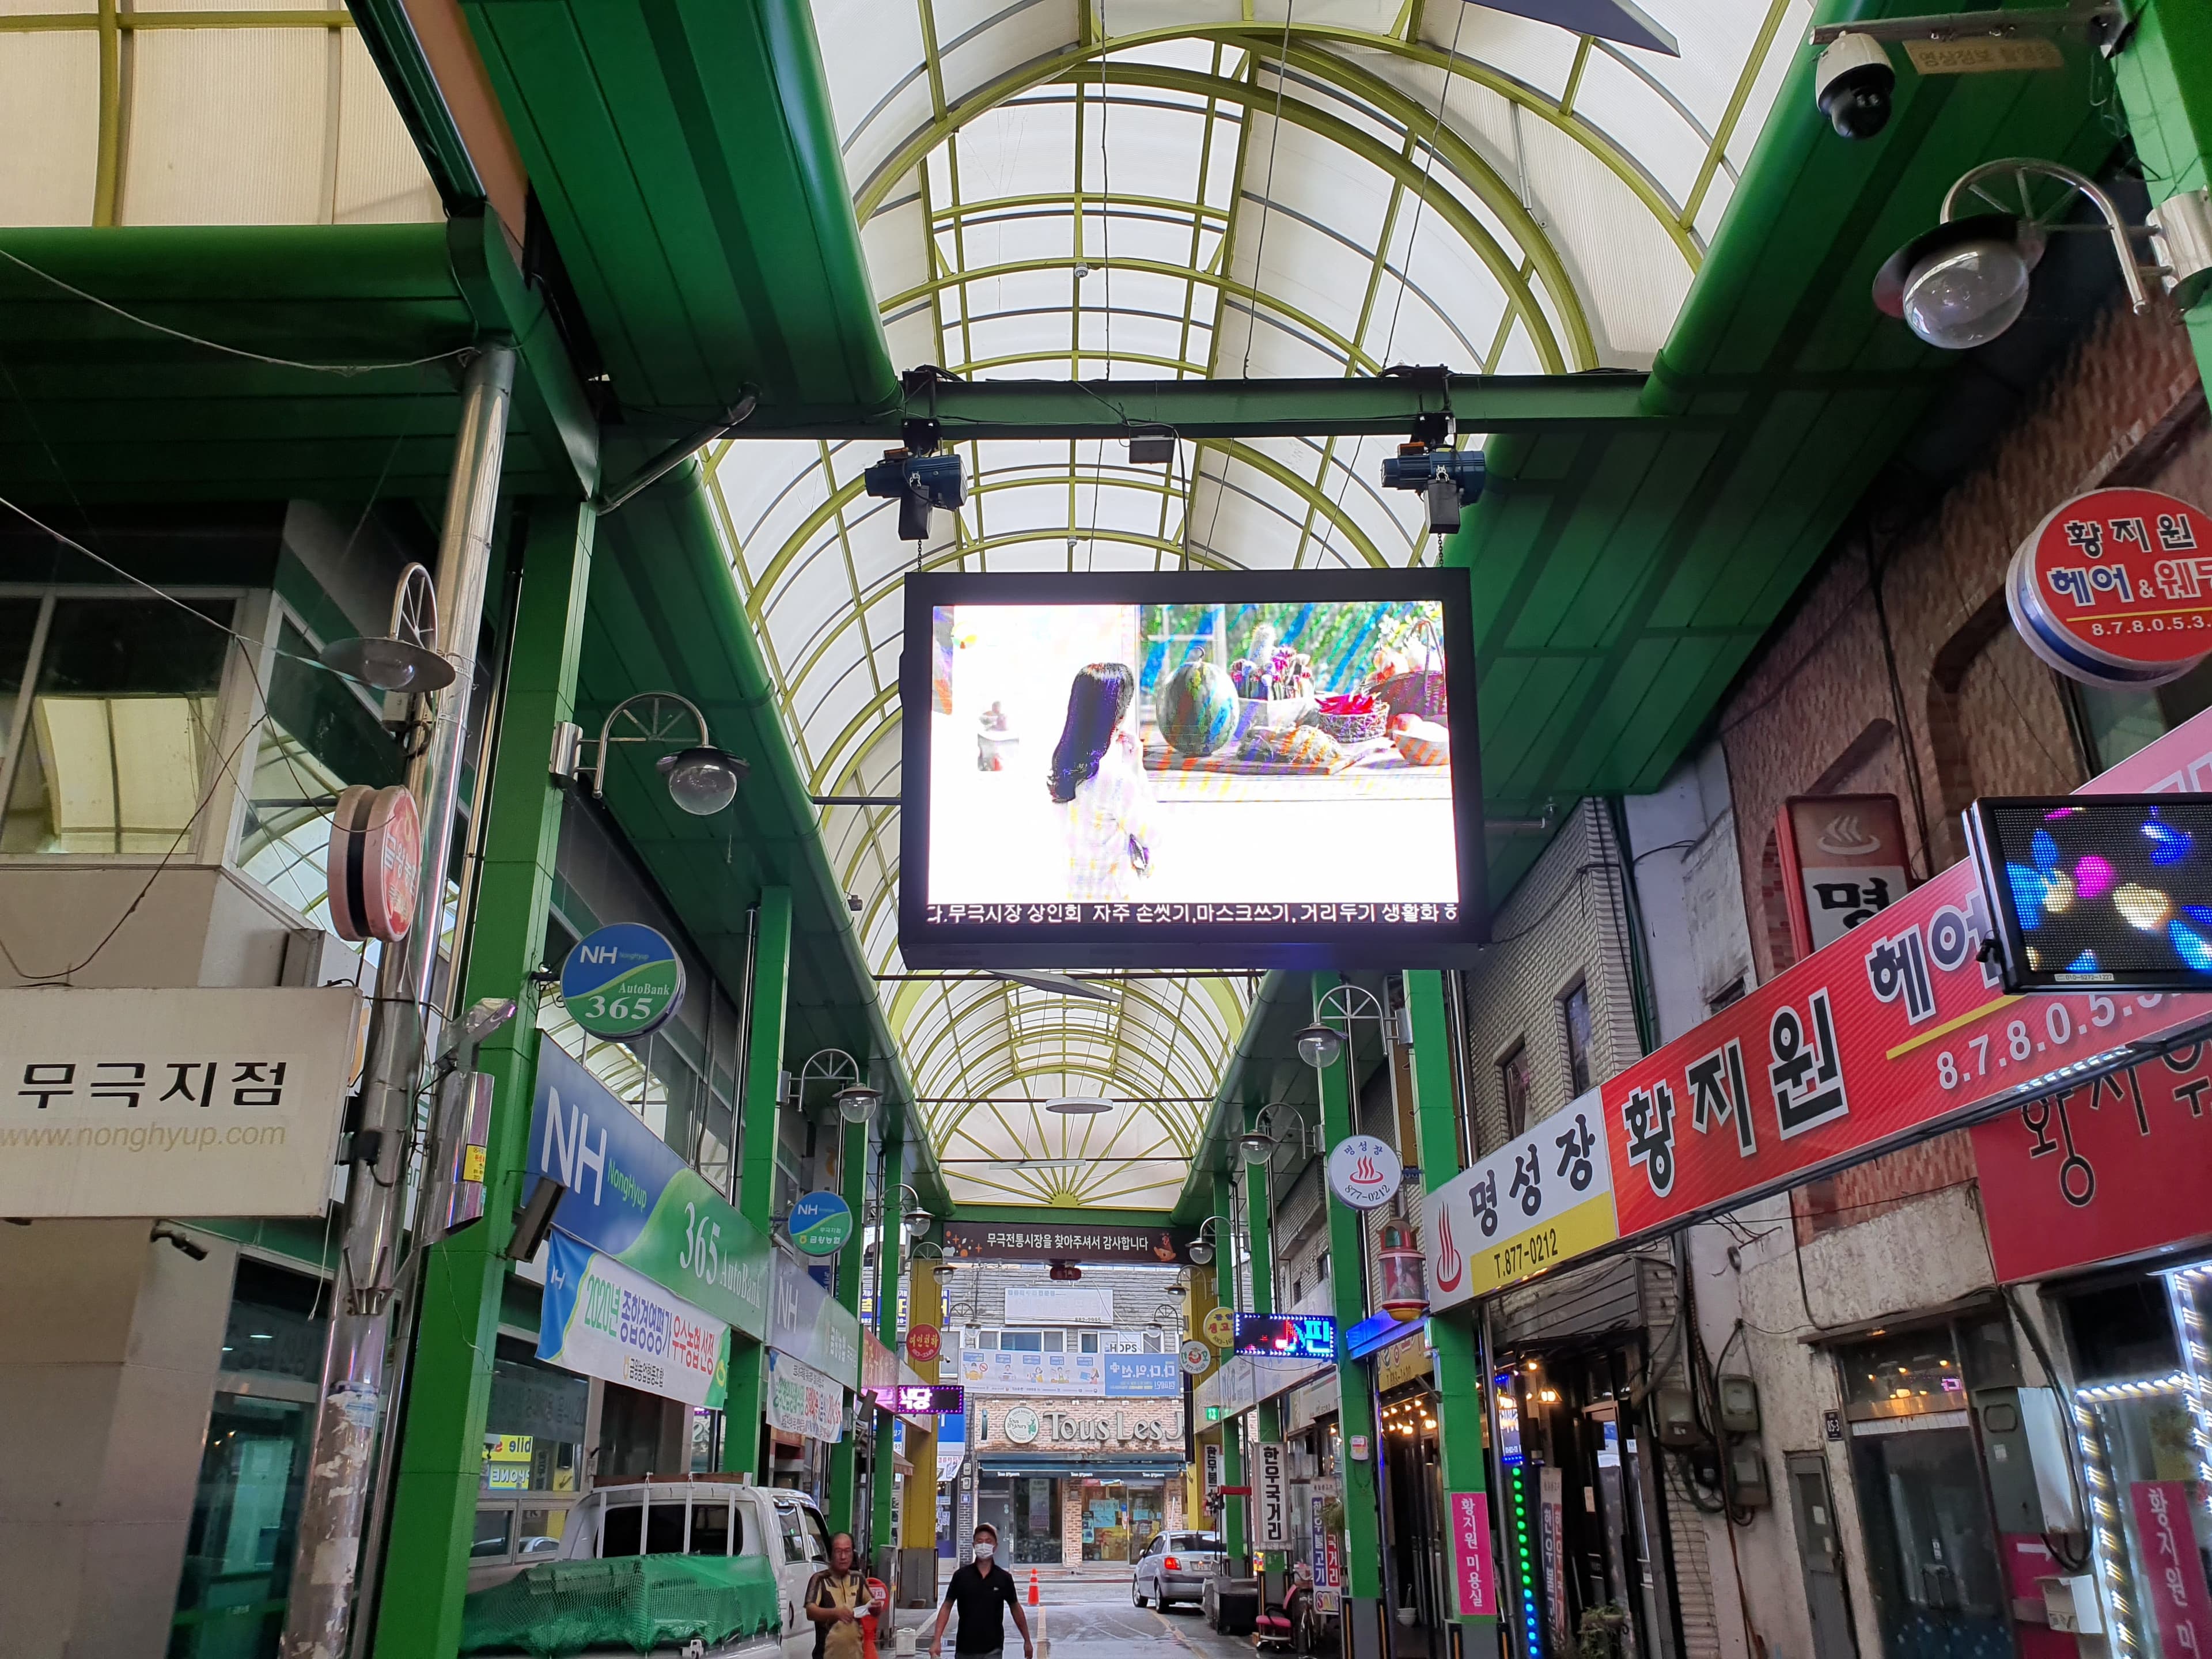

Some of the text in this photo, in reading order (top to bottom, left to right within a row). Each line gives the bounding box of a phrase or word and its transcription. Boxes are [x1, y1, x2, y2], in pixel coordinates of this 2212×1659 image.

[2064, 514, 2197, 558] 황지원
[2047, 565, 2135, 607] 헤어
[2139, 579, 2156, 598] &
[1028, 904, 1082, 923] 상인회
[1093, 904, 1131, 922] 자주
[1300, 903, 1376, 923] 거리두기
[1382, 903, 1439, 922] 생활화
[580, 945, 618, 964] NH
[585, 995, 653, 1020] 365
[619, 983, 670, 996] AutoBank
[18, 1062, 287, 1109] 무극지점
[1622, 987, 1849, 1198] 황지원
[0, 1122, 286, 1153] www.nonghyup.com
[541, 1085, 647, 1214] NH NongHyup
[1344, 1184, 1391, 1202] 877-0212
[1469, 1113, 1596, 1237] 명성장
[797, 1204, 818, 1215] NH
[679, 1202, 761, 1309] 365 AutoBank
[987, 1233, 1149, 1251] 무극전통시장을 찾아주셔서 감사합니다
[1494, 1228, 1558, 1279] T.877-0212
[584, 1274, 622, 1338] 2020년
[700, 1329, 715, 1375] 선정
[777, 1275, 799, 1334] NH
[909, 1333, 939, 1348] 여인천하
[1110, 1343, 1137, 1353] HOPS
[1044, 1411, 1109, 1441] Tous
[1116, 1411, 1164, 1441] Les
[1827, 1419, 1840, 1433] 85-3
[1263, 1446, 1282, 1541] 한우국거리
[1461, 1498, 1478, 1550] 황지원
[2149, 1487, 2188, 1607] 황지원
[1467, 1554, 1482, 1607] 미용실
